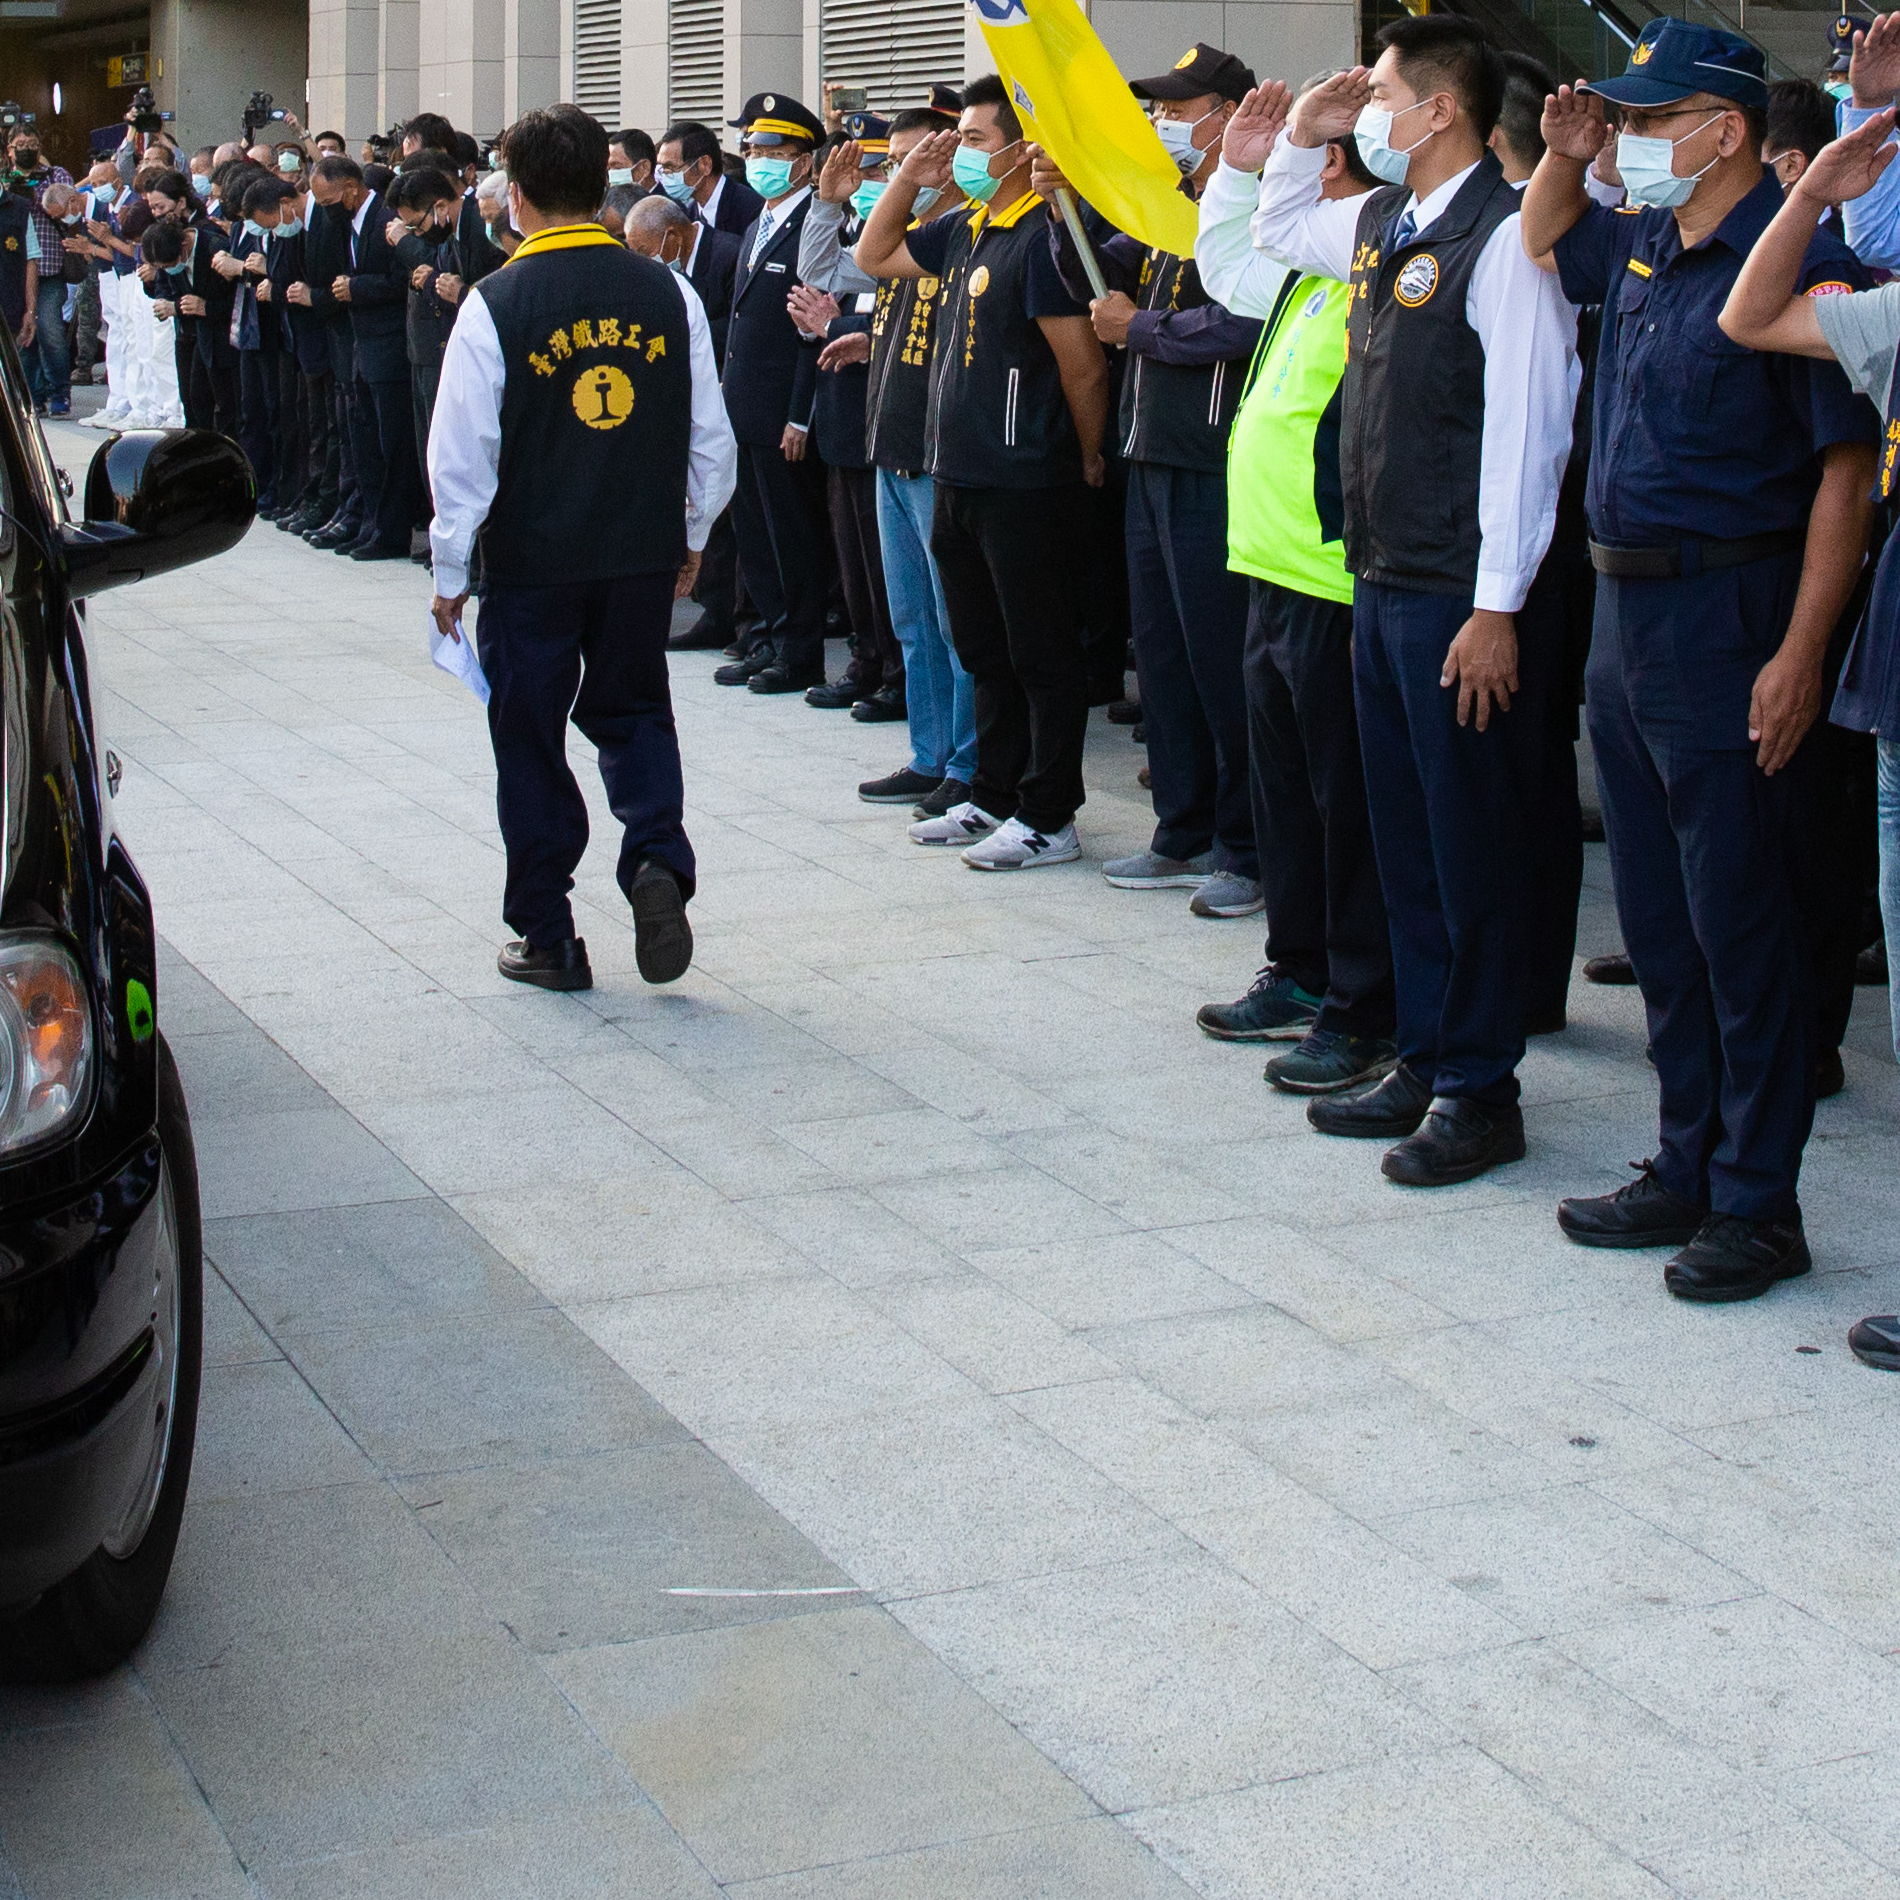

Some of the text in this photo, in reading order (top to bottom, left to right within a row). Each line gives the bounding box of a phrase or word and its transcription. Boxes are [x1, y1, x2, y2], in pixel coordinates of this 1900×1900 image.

[528, 317, 666, 378] 臺灣鐵路工會
